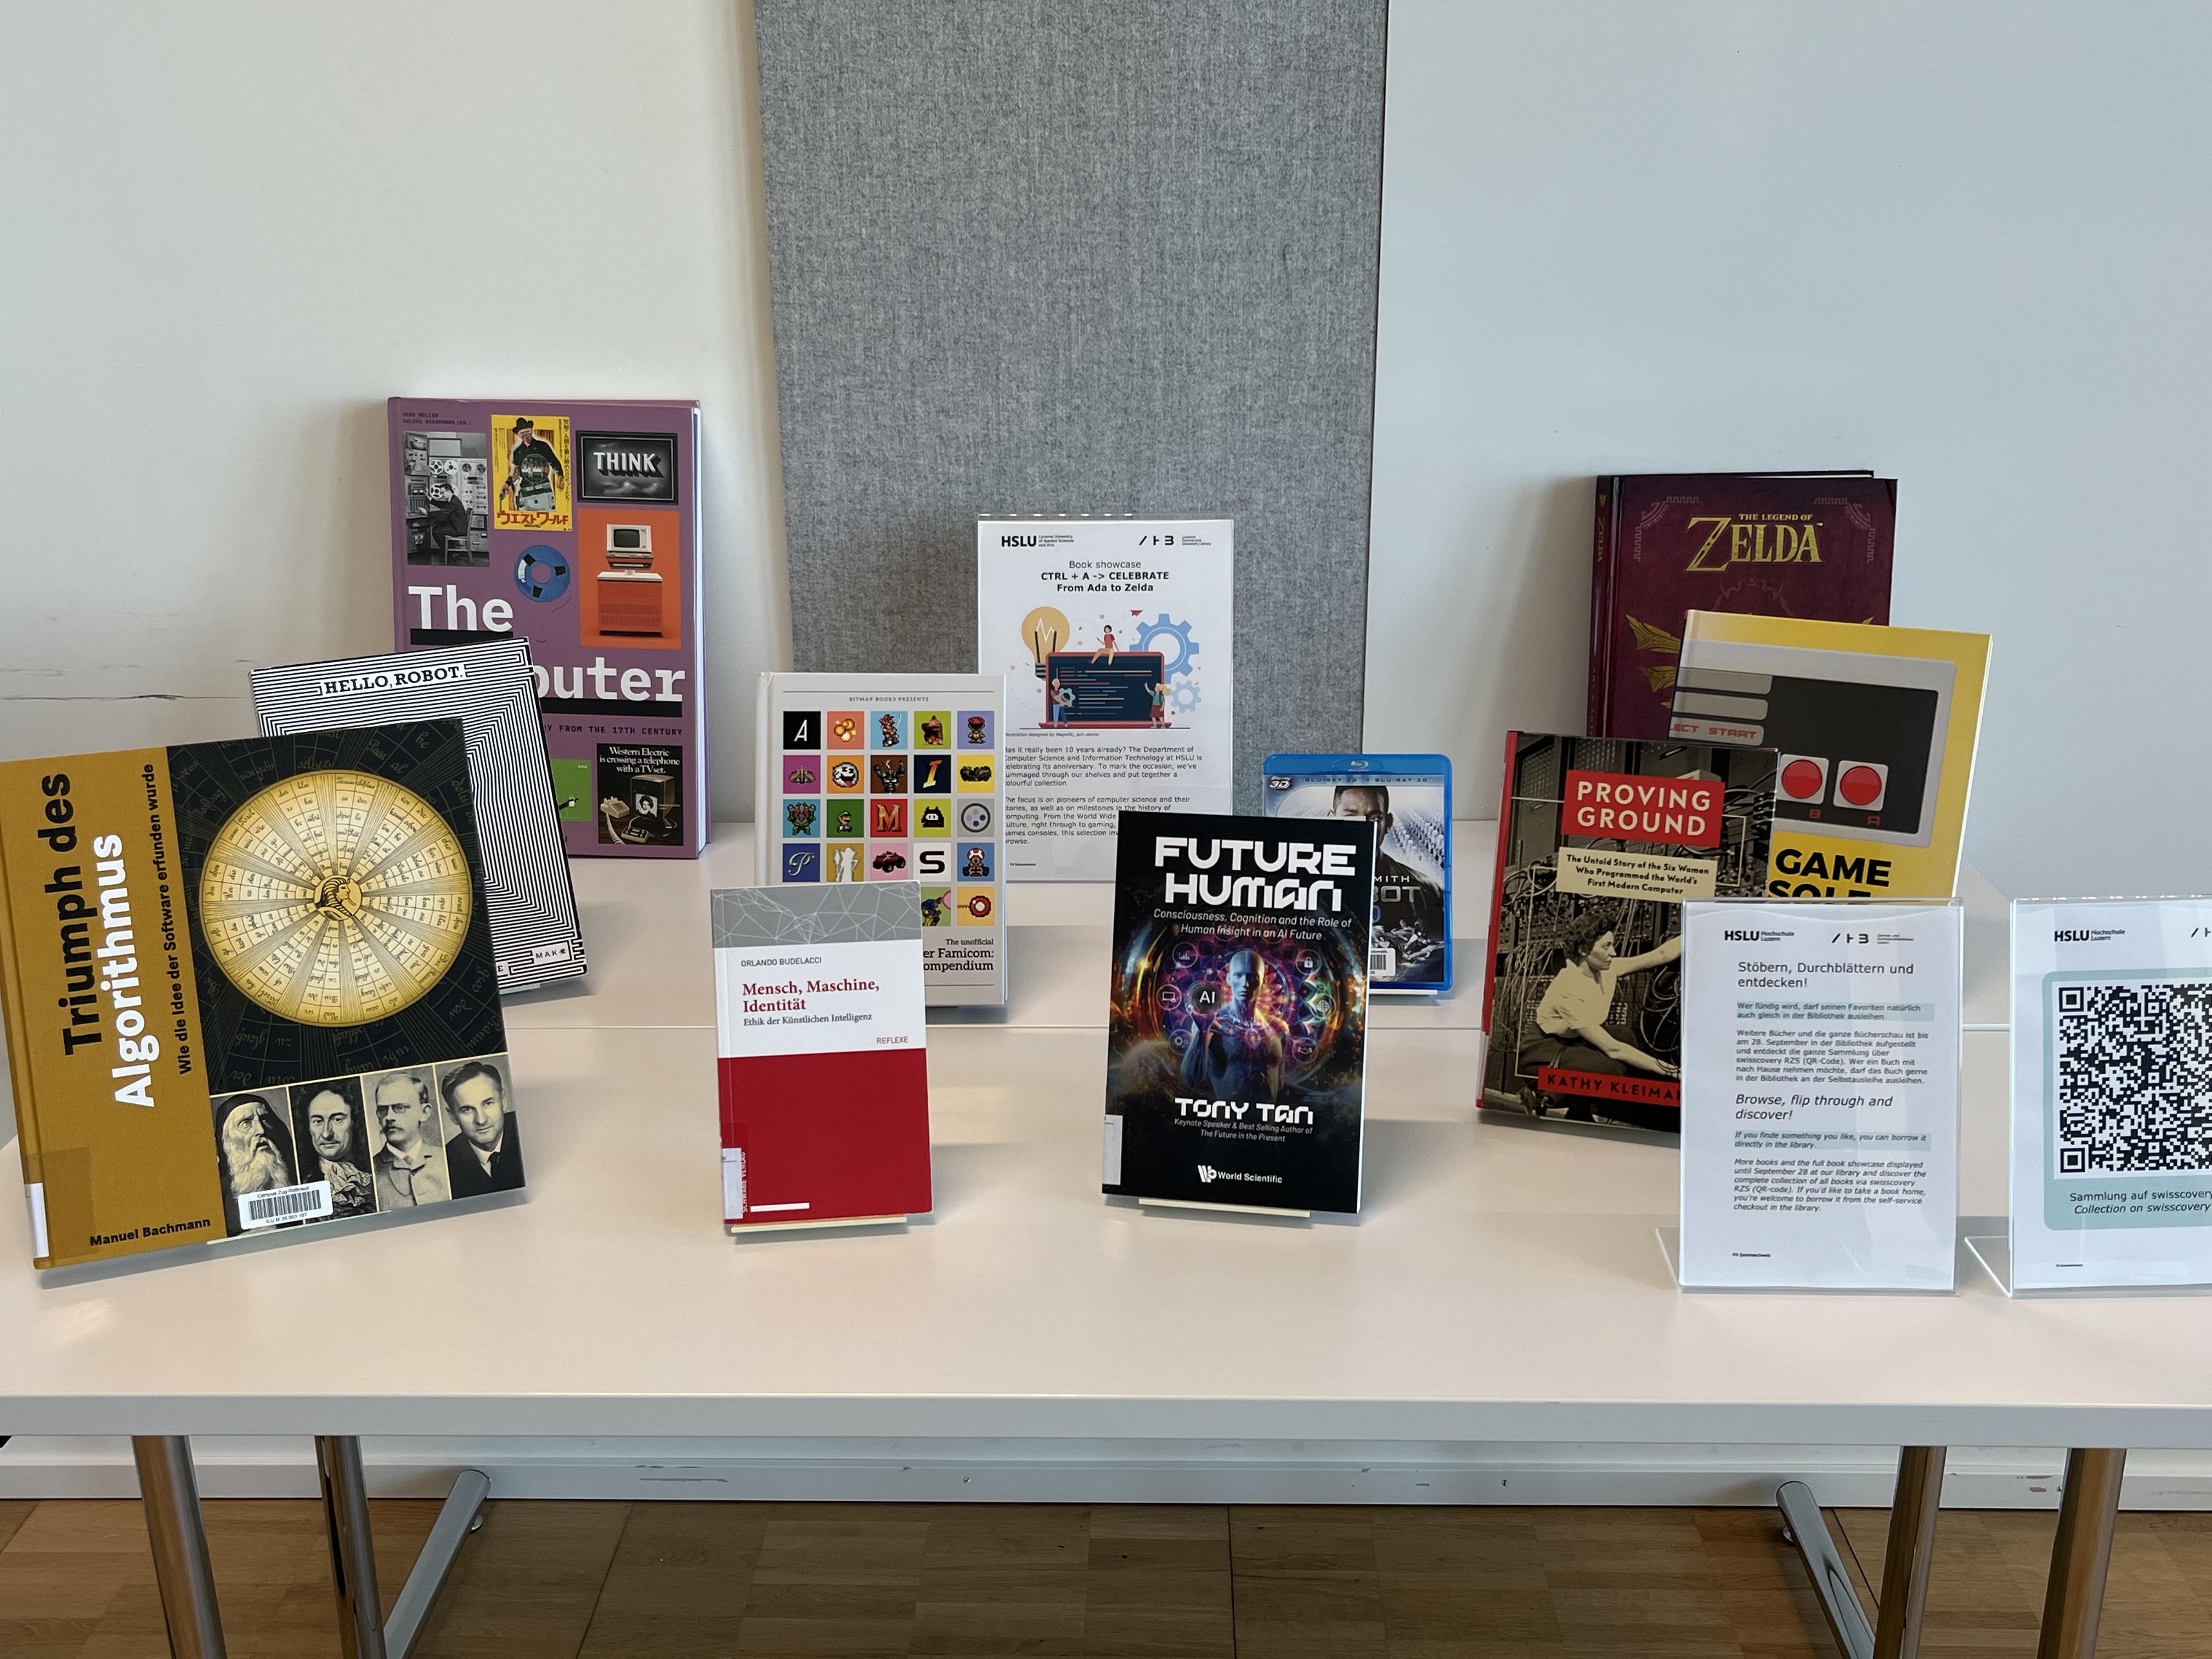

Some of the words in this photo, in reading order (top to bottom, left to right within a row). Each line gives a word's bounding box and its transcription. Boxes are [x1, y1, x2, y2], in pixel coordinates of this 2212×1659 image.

[594, 452, 656, 472] THINK
[1001, 535, 1036, 547] HSLU
[1685, 516, 1822, 572] ZELDA
[1069, 560, 1092, 569] Book
[1096, 560, 1141, 568] showcase
[1041, 572, 1068, 580] CTRL
[1109, 572, 1169, 580] CELEBRATE
[1087, 583, 1107, 591] Ada
[1125, 583, 1153, 591] Zelda
[409, 585, 514, 633] The
[1708, 727, 1757, 739] START
[609, 747, 640, 755] Western
[642, 748, 669, 756] Electric
[606, 755, 637, 765] crossing
[644, 757, 680, 766] telephone
[142, 764, 159, 811] wurde
[1577, 781, 1710, 811] PROVING
[37, 774, 77, 852] des
[1577, 806, 1705, 836] GROUND
[149, 814, 167, 881] erfunden
[1155, 836, 1356, 876] FUTURE
[1566, 854, 1581, 862] The
[1583, 856, 1612, 866] Untold
[1613, 859, 1636, 869] Story
[1648, 862, 1661, 870] the
[1663, 863, 1675, 871] Six
[1678, 864, 1709, 874] Women
[1775, 849, 1892, 887] GAME
[1374, 874, 1409, 883] MITH
[1576, 866, 1594, 874] Who
[1596, 868, 1650, 880] Programmed
[1667, 874, 1697, 884] World's
[1587, 878, 1605, 887] First
[1607, 881, 1639, 890] Modern
[1641, 883, 1683, 894] Computer
[159, 884, 176, 951] Software
[1154, 909, 1227, 922] Consciousness,
[1230, 912, 1277, 924] Cognition
[1278, 916, 1297, 925] and
[1299, 916, 1316, 926] the
[1317, 917, 1339, 927] Role
[1341, 918, 1352, 927] of
[1181, 924, 1215, 935] Human
[1217, 924, 1250, 938] Insight
[1252, 927, 1261, 936] in
[1263, 930, 1276, 939] an
[1277, 929, 1288, 939] AI
[1289, 929, 1322, 940] Future
[1724, 930, 1759, 941] HSLU
[2054, 930, 2089, 942] HSLU
[44, 866, 102, 1056] Triumph
[938, 947, 994, 961] Famicom:
[166, 955, 180, 979] der
[741, 958, 777, 967] ORLANDO
[779, 957, 822, 965] BUDELACCI
[924, 960, 994, 973] ompendium
[1738, 962, 1792, 974] Stöbern,
[1797, 962, 1884, 973] Durchblättern
[1890, 963, 1914, 974] und
[93, 834, 160, 1107] Algorithmus
[743, 981, 802, 996] Mensch,
[806, 978, 879, 992] Maschine,
[1738, 977, 1807, 988] entdecken!
[171, 983, 185, 1015] Idee
[1199, 991, 1215, 1003] AI
[743, 998, 806, 1013] Identität
[1755, 1002, 1779, 1011] fündig
[743, 1017, 765, 1026] Ethik
[766, 1017, 780, 1025] der
[782, 1015, 829, 1024] Künstlichen
[831, 1013, 872, 1023] Intelligenz
[174, 1019, 188, 1041] die
[877, 1036, 908, 1044] REFLEXE
[177, 1045, 191, 1075] Wie
[1548, 1074, 1602, 1090] KATHY
[1736, 1094, 1785, 1107] Browse,
[1791, 1094, 1810, 1107] flip
[1815, 1095, 1864, 1108] through
[1869, 1096, 1893, 1107] and
[1175, 1097, 1249, 1120] TONY
[1256, 1103, 1313, 1125] TAN
[1735, 1109, 1793, 1120] discover!
[1214, 1130, 1237, 1138] Future
[1259, 1133, 1285, 1142] Present
[1217, 1171, 1242, 1180] World
[1244, 1173, 1282, 1183] Scientific
[2070, 1192, 2126, 1202] Sammlung
[2131, 1190, 2148, 1200] auf
[1795, 1204, 1821, 1212] library.
[2074, 1204, 2126, 1214] Collection
[2147, 1202, 2211, 1213] swisscovery
[89, 1228, 139, 1246] Manuel
[142, 1219, 211, 1237] Bachmann
